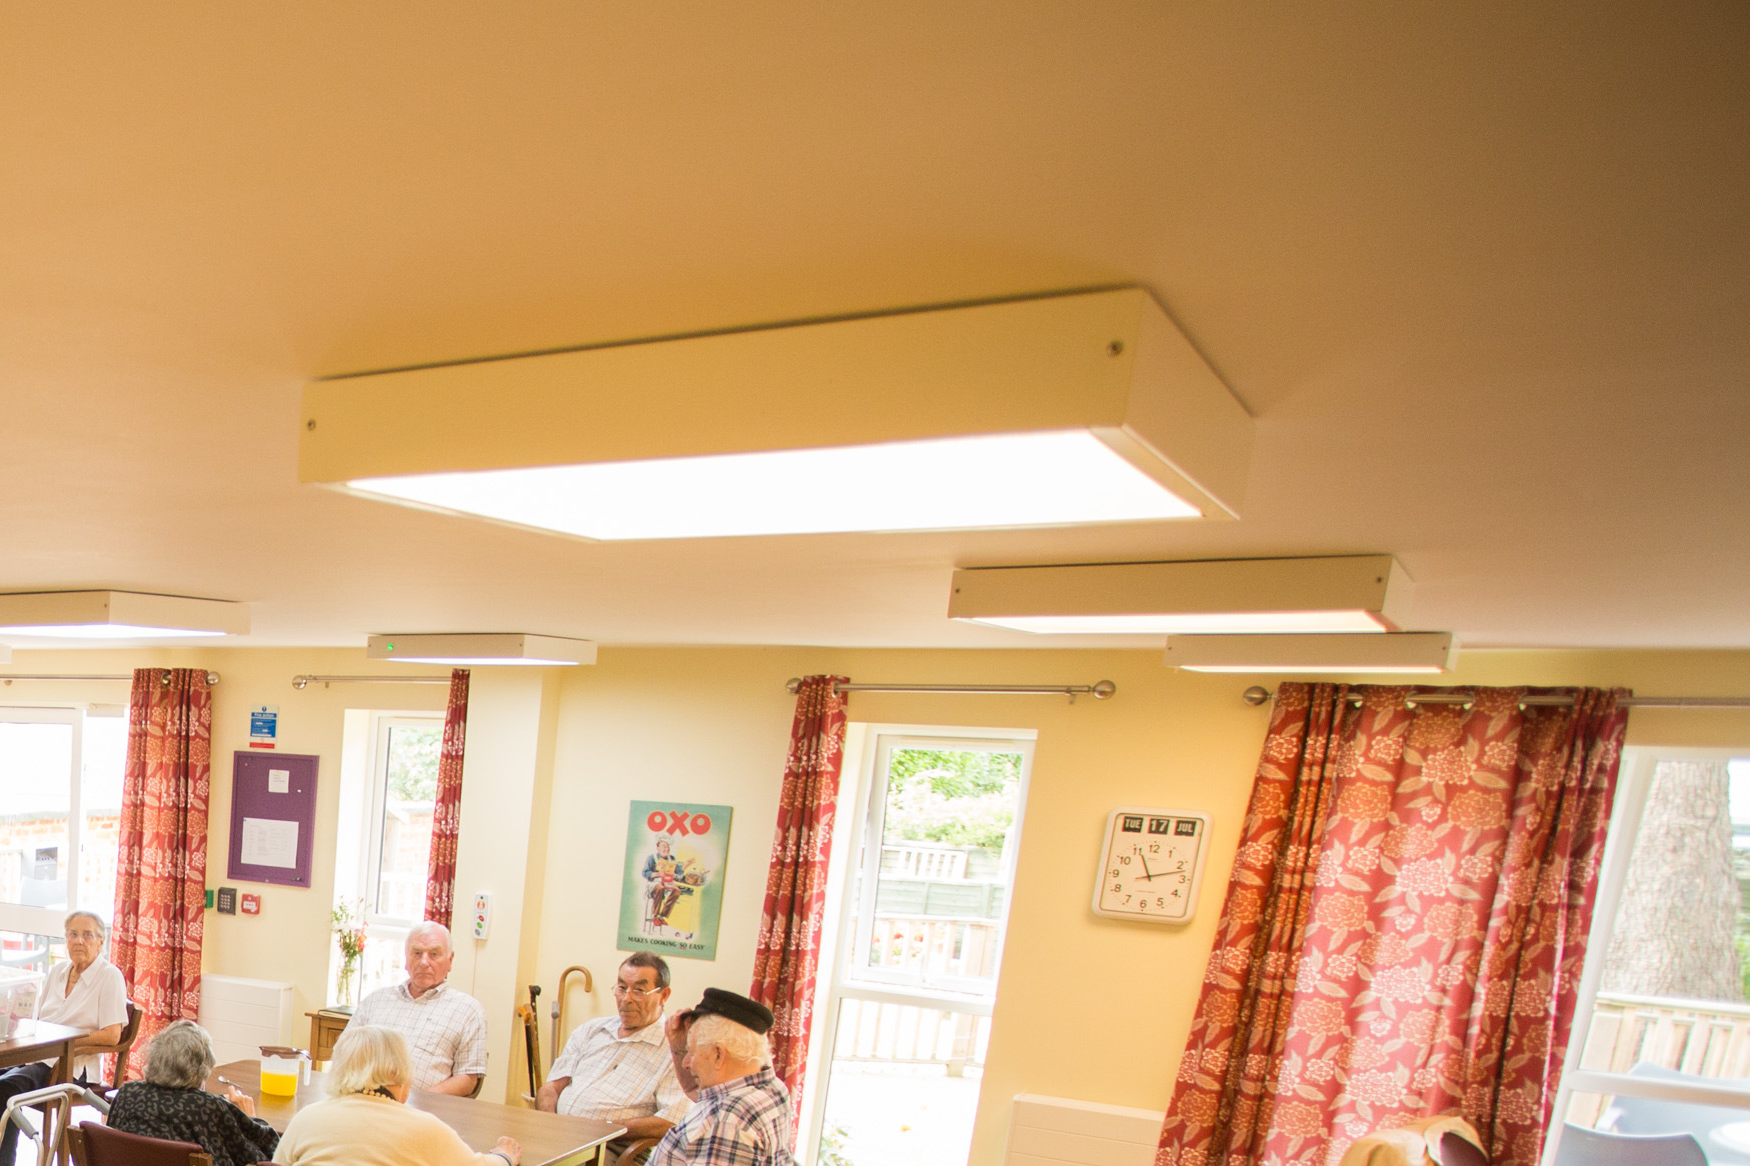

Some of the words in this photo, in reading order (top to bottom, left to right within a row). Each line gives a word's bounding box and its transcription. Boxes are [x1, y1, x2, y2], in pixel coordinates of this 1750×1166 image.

[647, 809, 712, 838] OXO
[1125, 819, 1141, 829] TUE
[1150, 820, 1168, 832] 17
[1176, 822, 1193, 833] JUL
[1133, 846, 1142, 856] 11
[1149, 844, 1160, 854] 12
[1168, 850, 1172, 858] 1
[1120, 856, 1131, 866] 10
[1176, 860, 1184, 870] 2
[1112, 869, 1120, 878] 9
[1178, 874, 1186, 884] 3
[1114, 884, 1122, 892] 8
[1171, 889, 1178, 898] 4
[1125, 894, 1132, 904] 7
[1140, 900, 1147, 908] 6
[1156, 898, 1164, 906] 5
[628, 936, 648, 944] MAKES
[650, 939, 676, 948] COOKING
